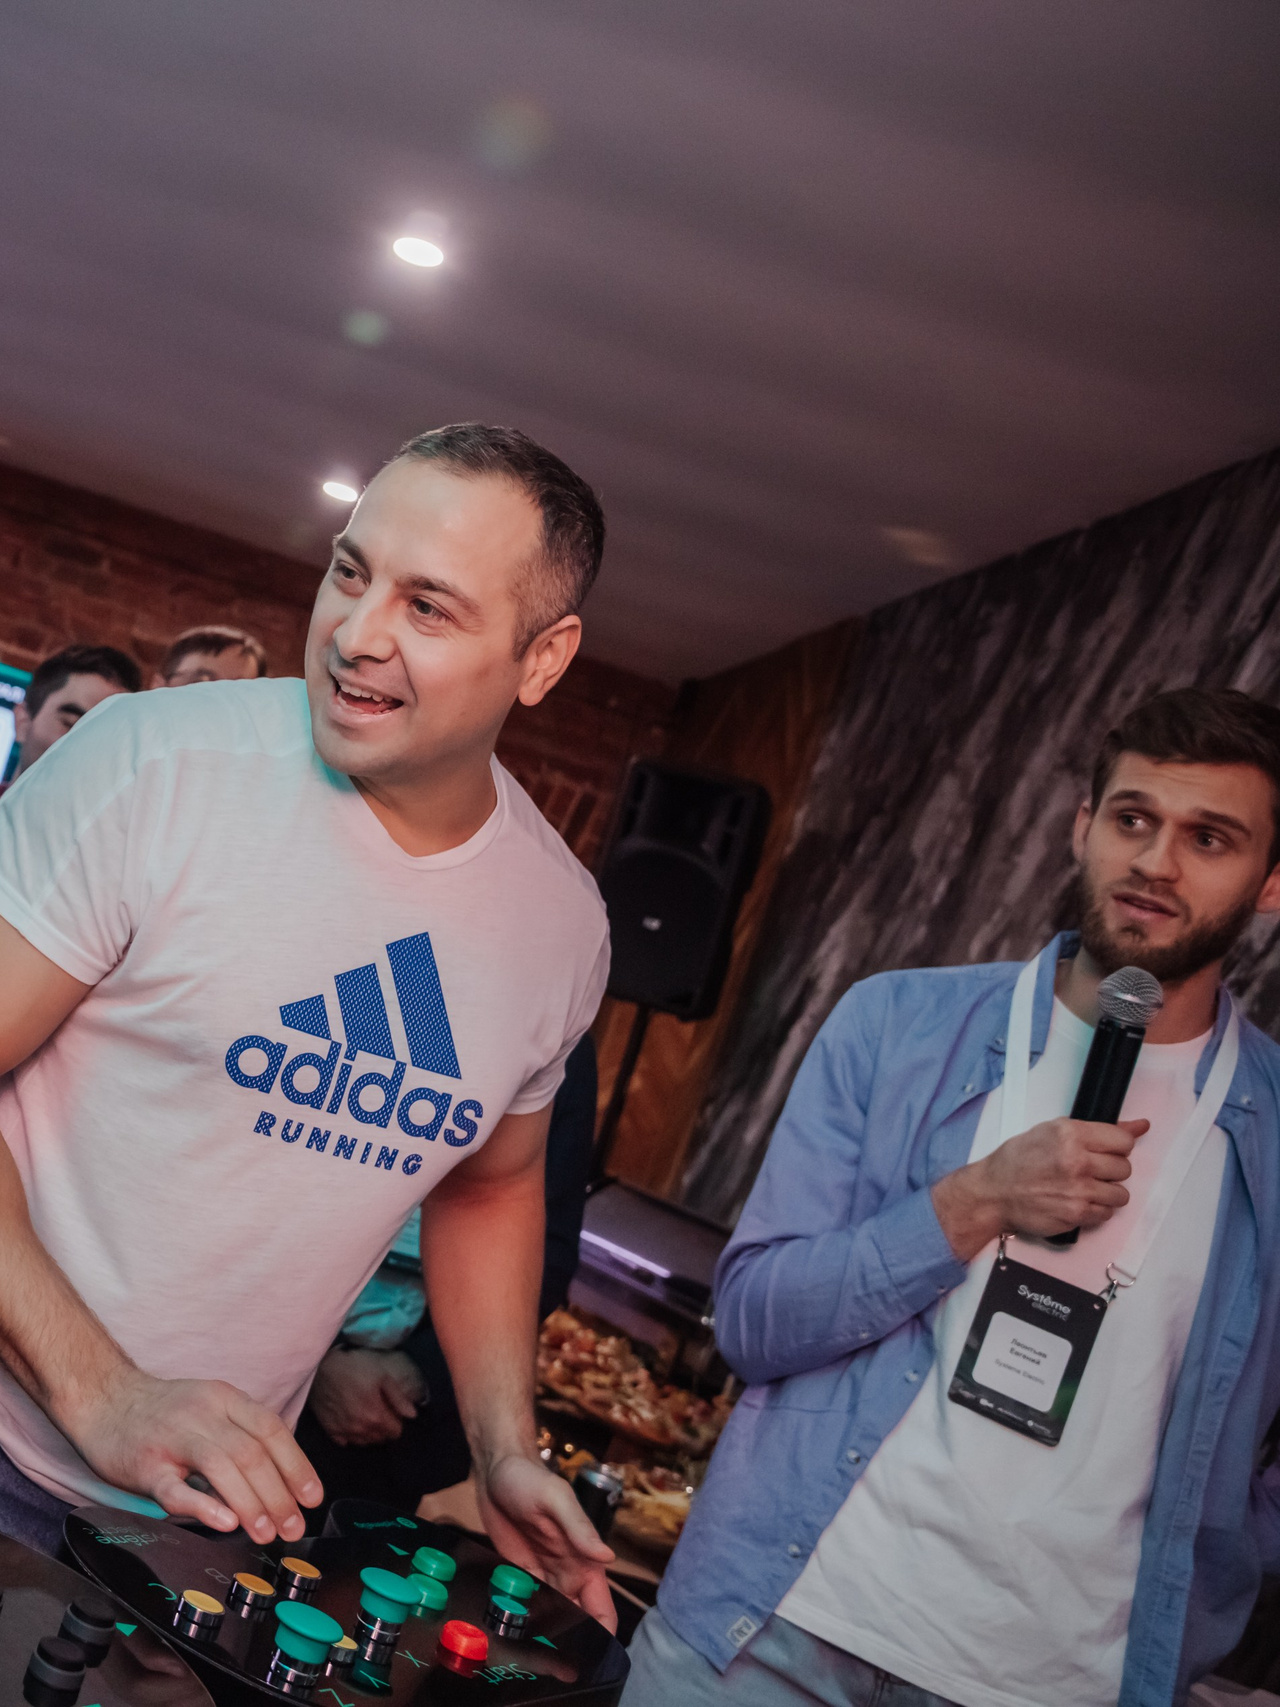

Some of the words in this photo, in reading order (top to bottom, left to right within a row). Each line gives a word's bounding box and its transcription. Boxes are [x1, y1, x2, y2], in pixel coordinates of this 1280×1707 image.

[225, 1034, 484, 1148] adidas
[253, 1110, 424, 1176] RUNNING
[472, 1662, 538, 1687] Start
